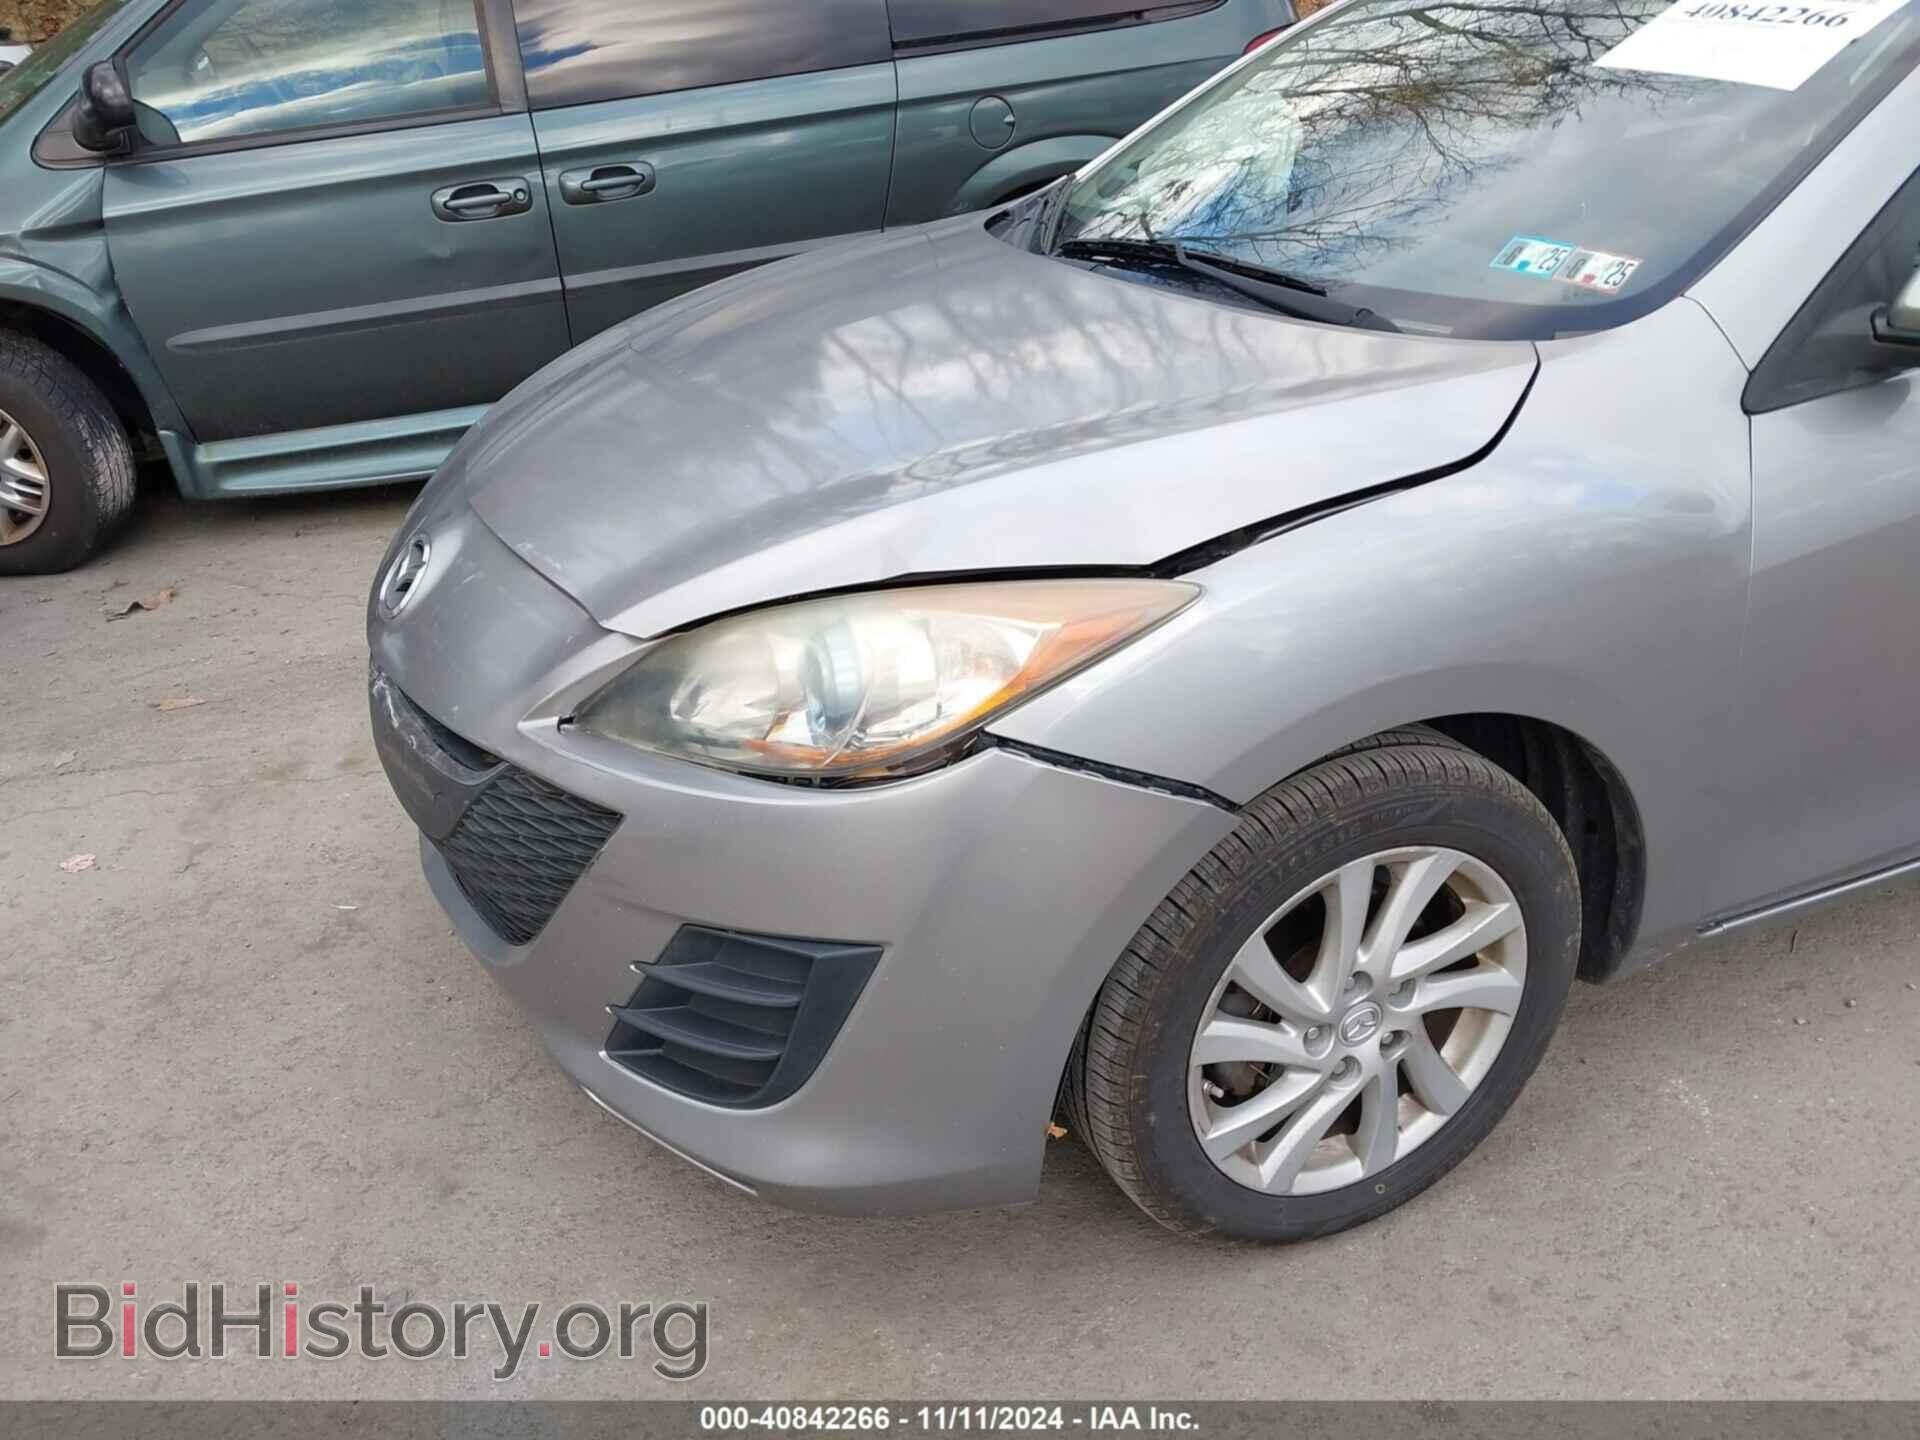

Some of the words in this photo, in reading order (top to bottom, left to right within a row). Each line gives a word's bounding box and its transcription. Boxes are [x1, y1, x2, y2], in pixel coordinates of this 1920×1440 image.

[1684, 2, 1854, 28] 40842266
[1538, 247, 1568, 272] 25
[1604, 261, 1635, 287] 25
